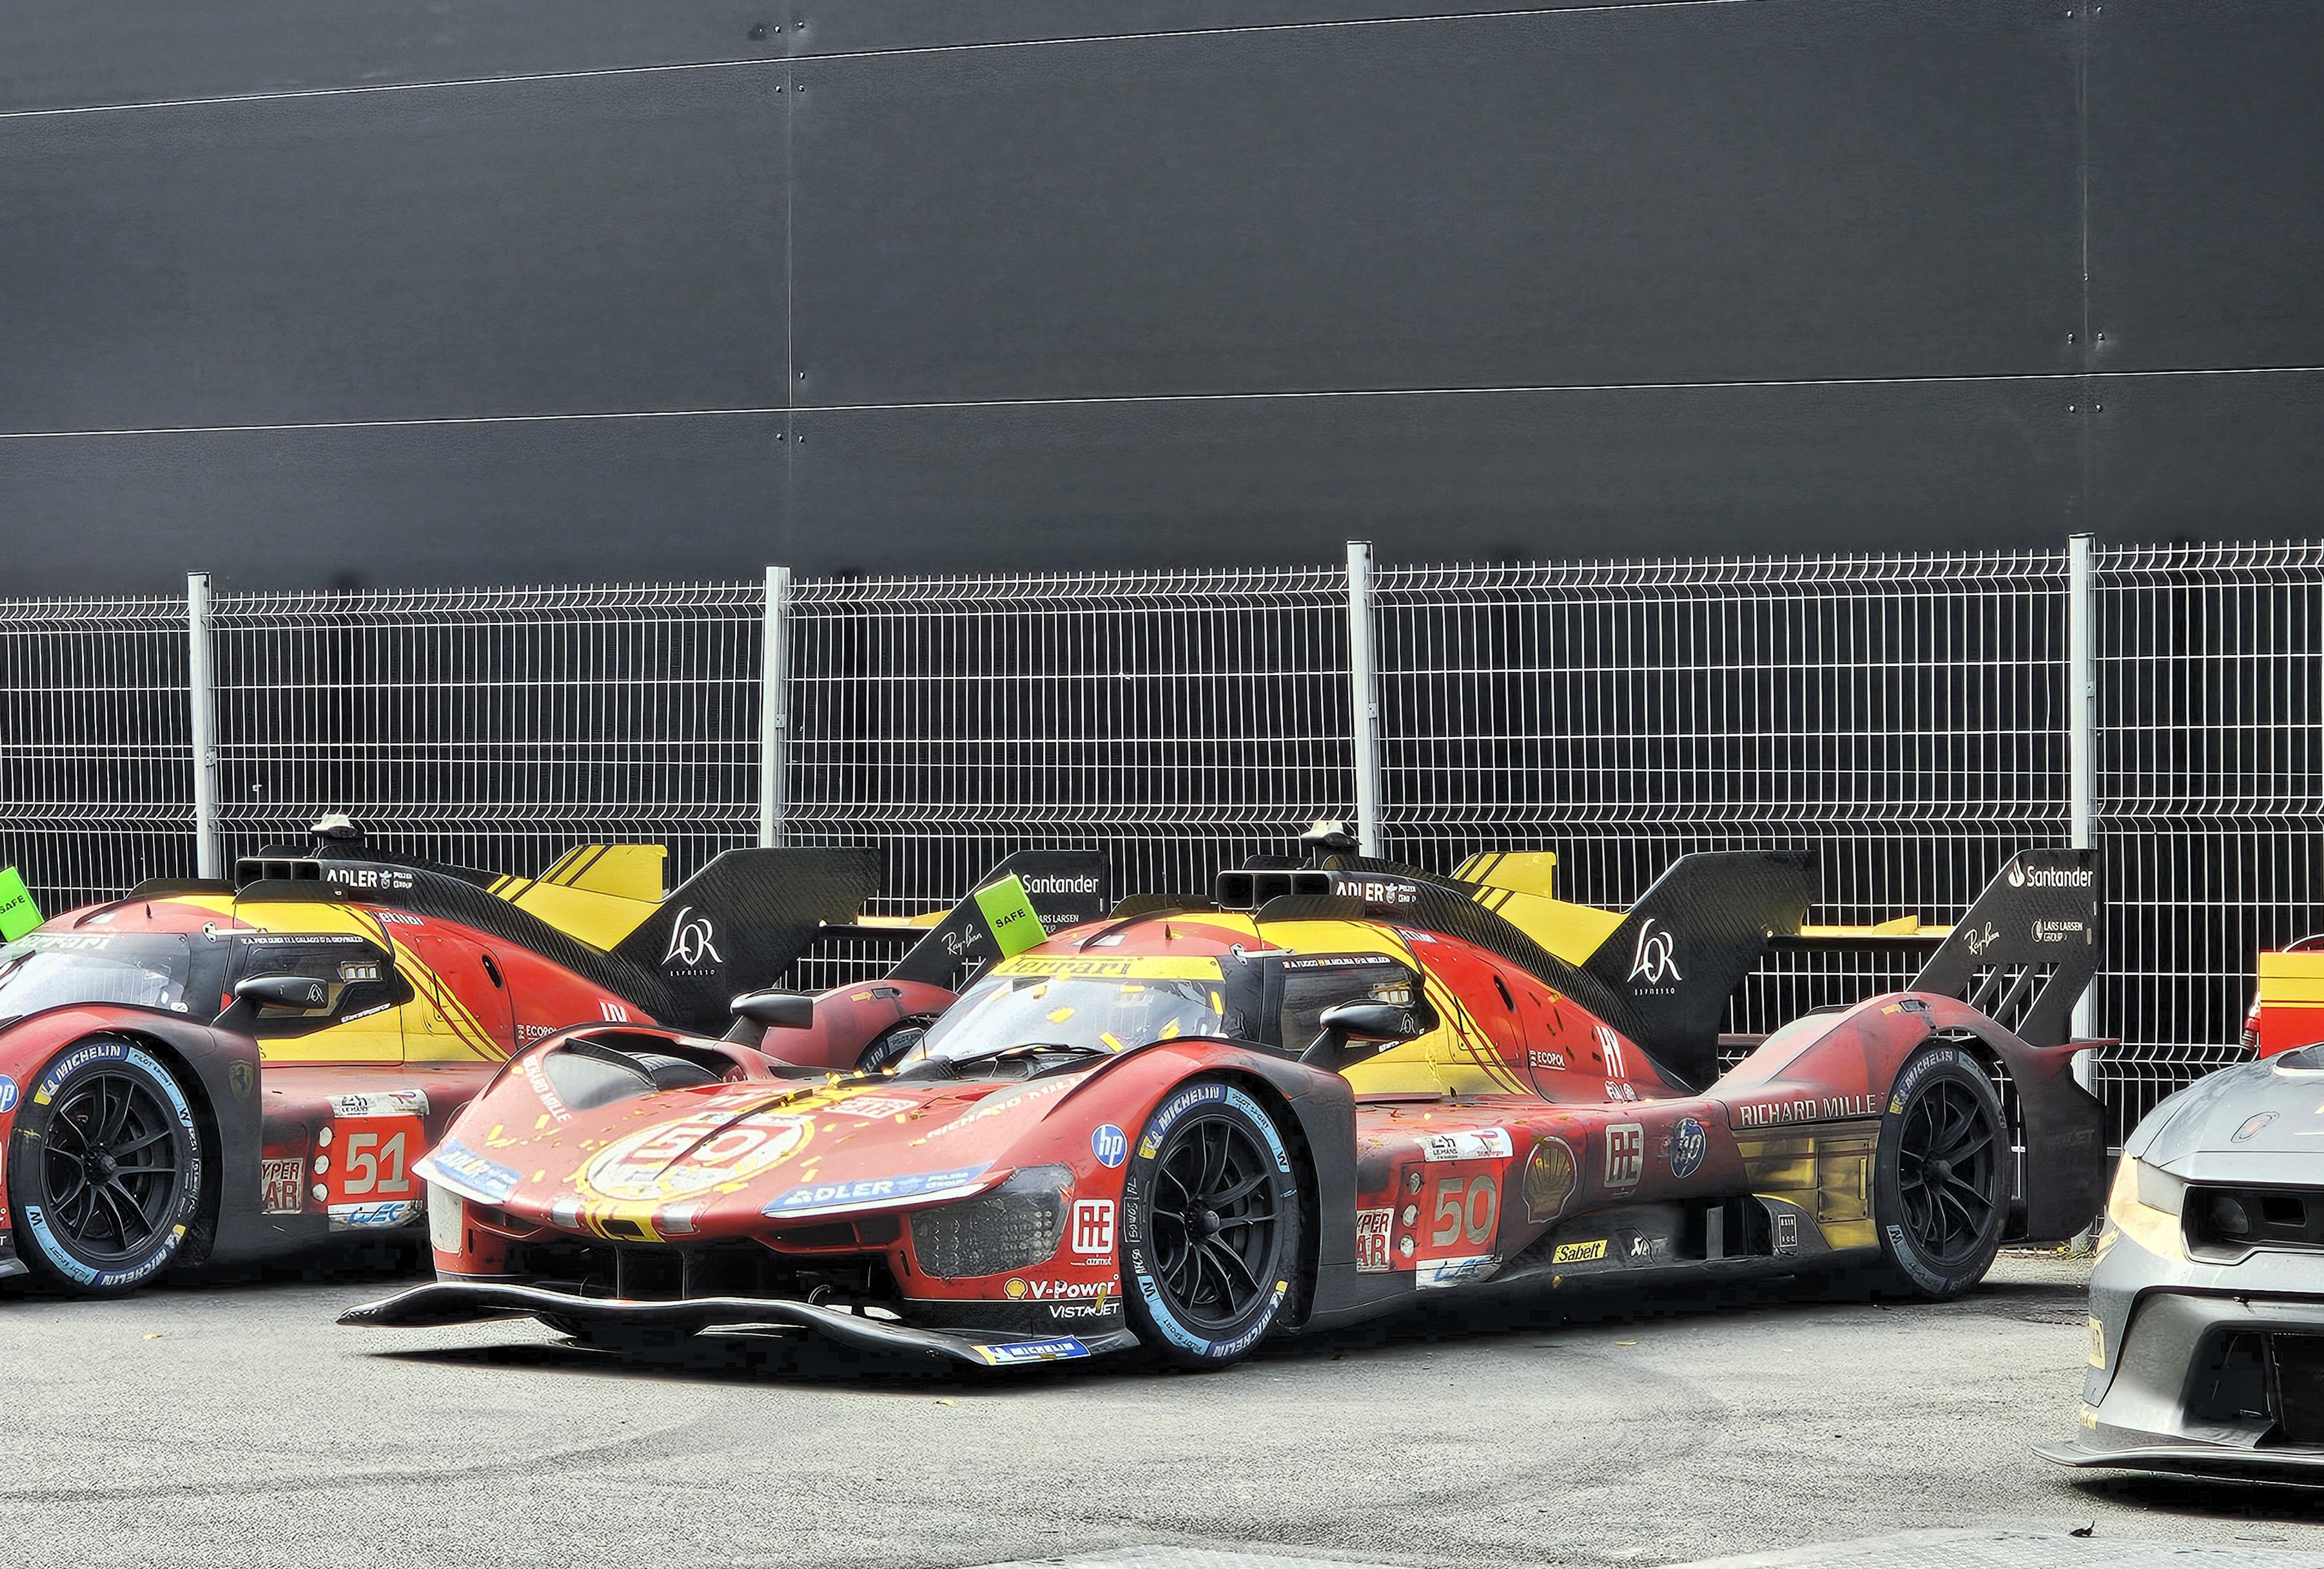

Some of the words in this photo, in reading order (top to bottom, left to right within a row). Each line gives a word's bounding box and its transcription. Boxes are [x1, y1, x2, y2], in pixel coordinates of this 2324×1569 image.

[326, 869, 378, 888] ADLER
[1022, 874, 1099, 893] Santander
[2027, 866, 2093, 887] Santander
[995, 908, 1026, 928] SAFE
[56, 1044, 121, 1081] MICHELIN
[1904, 1050, 1954, 1090] MICHELIN
[1158, 1086, 1220, 1130] MICHELIN
[1739, 1099, 1817, 1126] RICHARD
[1822, 1094, 1877, 1119] MILLE
[1099, 1126, 1124, 1167] hp
[262, 1162, 300, 1180] YPER
[344, 1132, 409, 1194] 51
[263, 1181, 297, 1209] AR
[783, 1180, 894, 1205] ADLER
[1432, 1174, 1497, 1248] 50
[1356, 1233, 1386, 1267] AR
[1559, 1243, 1600, 1262] Sabelt
[101, 1247, 168, 1287] MICHELIN
[1029, 1280, 1115, 1300] V-Power
[1213, 1309, 1273, 1358] MICHELIN
[1010, 1341, 1075, 1357] MICHELIN
